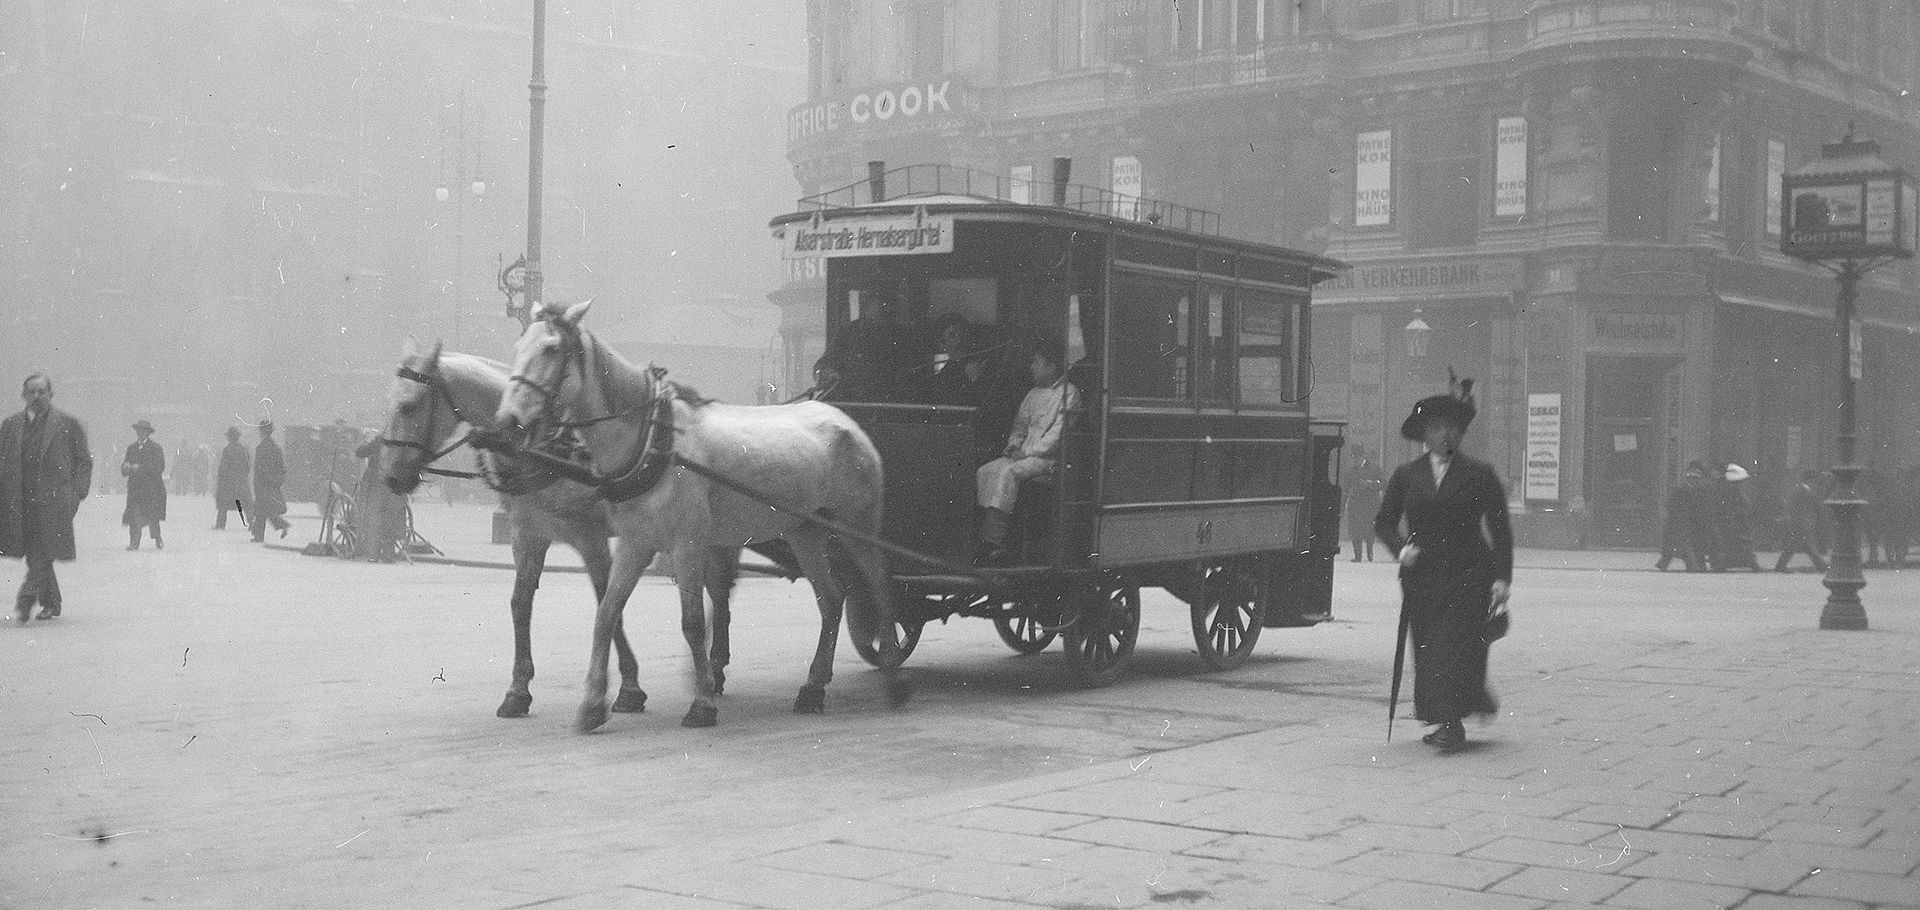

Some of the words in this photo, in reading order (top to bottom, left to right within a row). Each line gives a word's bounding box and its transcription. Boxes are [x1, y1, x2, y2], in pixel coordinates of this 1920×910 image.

[850, 80, 951, 123] COOK
[1359, 152, 1390, 164] KOK
[1114, 175, 1140, 186] KOK
[1497, 180, 1526, 190] KINO
[1358, 189, 1390, 201] KINO
[1361, 265, 1480, 289] VERKEHRSBANK
